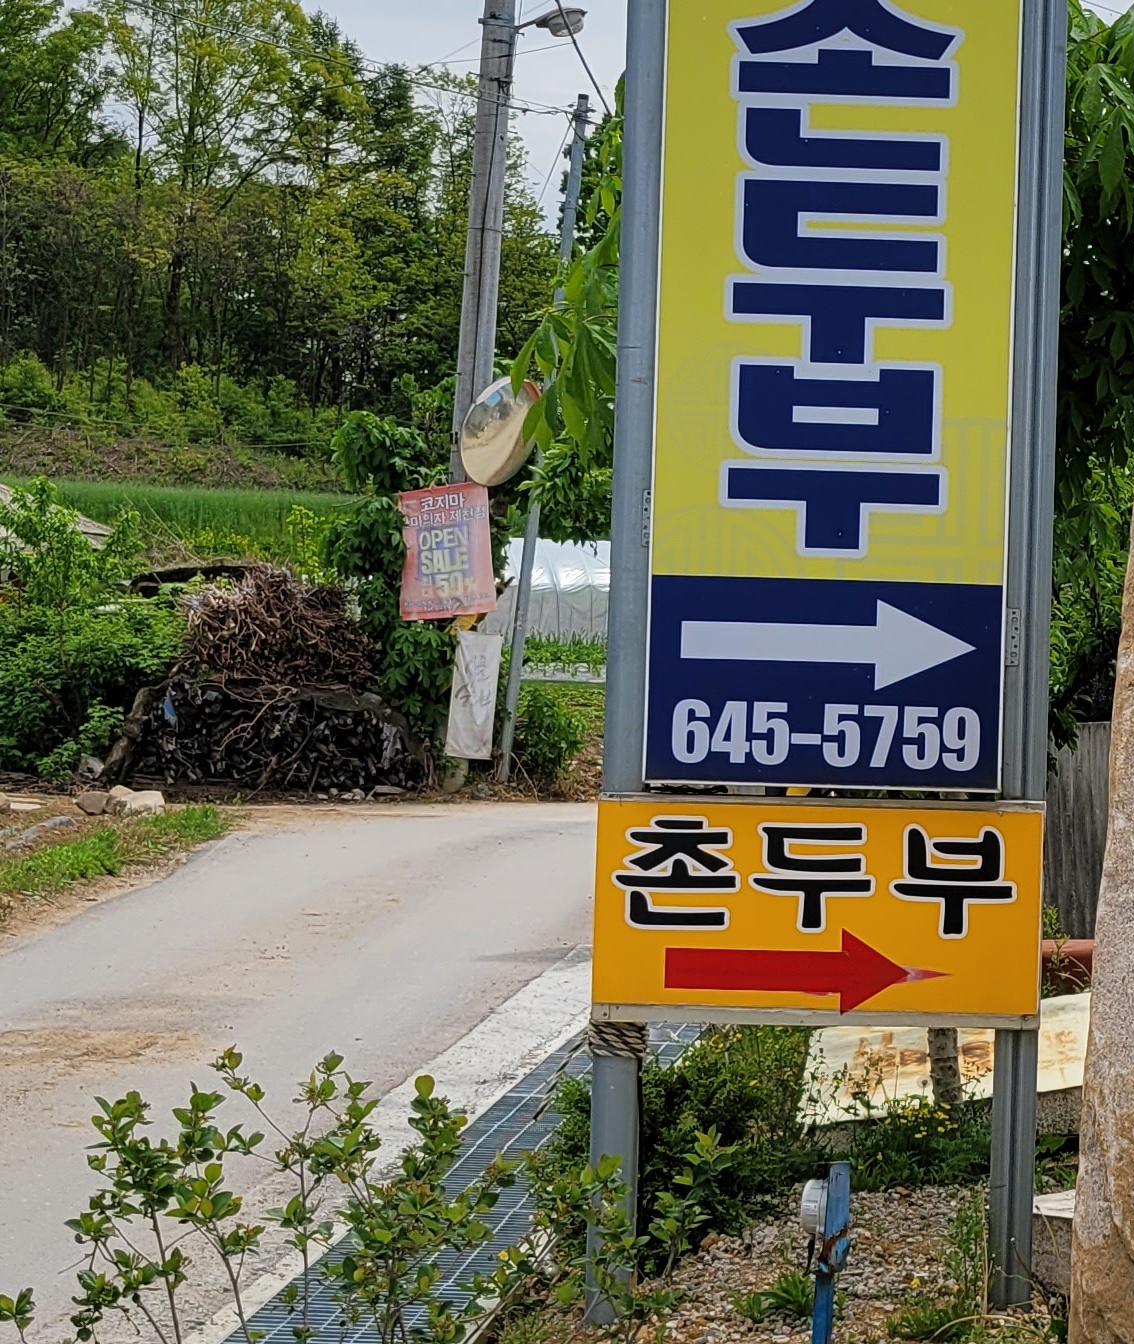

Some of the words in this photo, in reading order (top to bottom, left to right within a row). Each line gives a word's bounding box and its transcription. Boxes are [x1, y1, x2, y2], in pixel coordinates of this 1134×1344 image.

[420, 491, 466, 513] 코지마
[449, 505, 486, 523] 제천점
[419, 525, 469, 550] OPEN
[420, 547, 469, 575] SALE
[670, 698, 982, 772] 645-5759
[613, 817, 1016, 938] 촌두부
